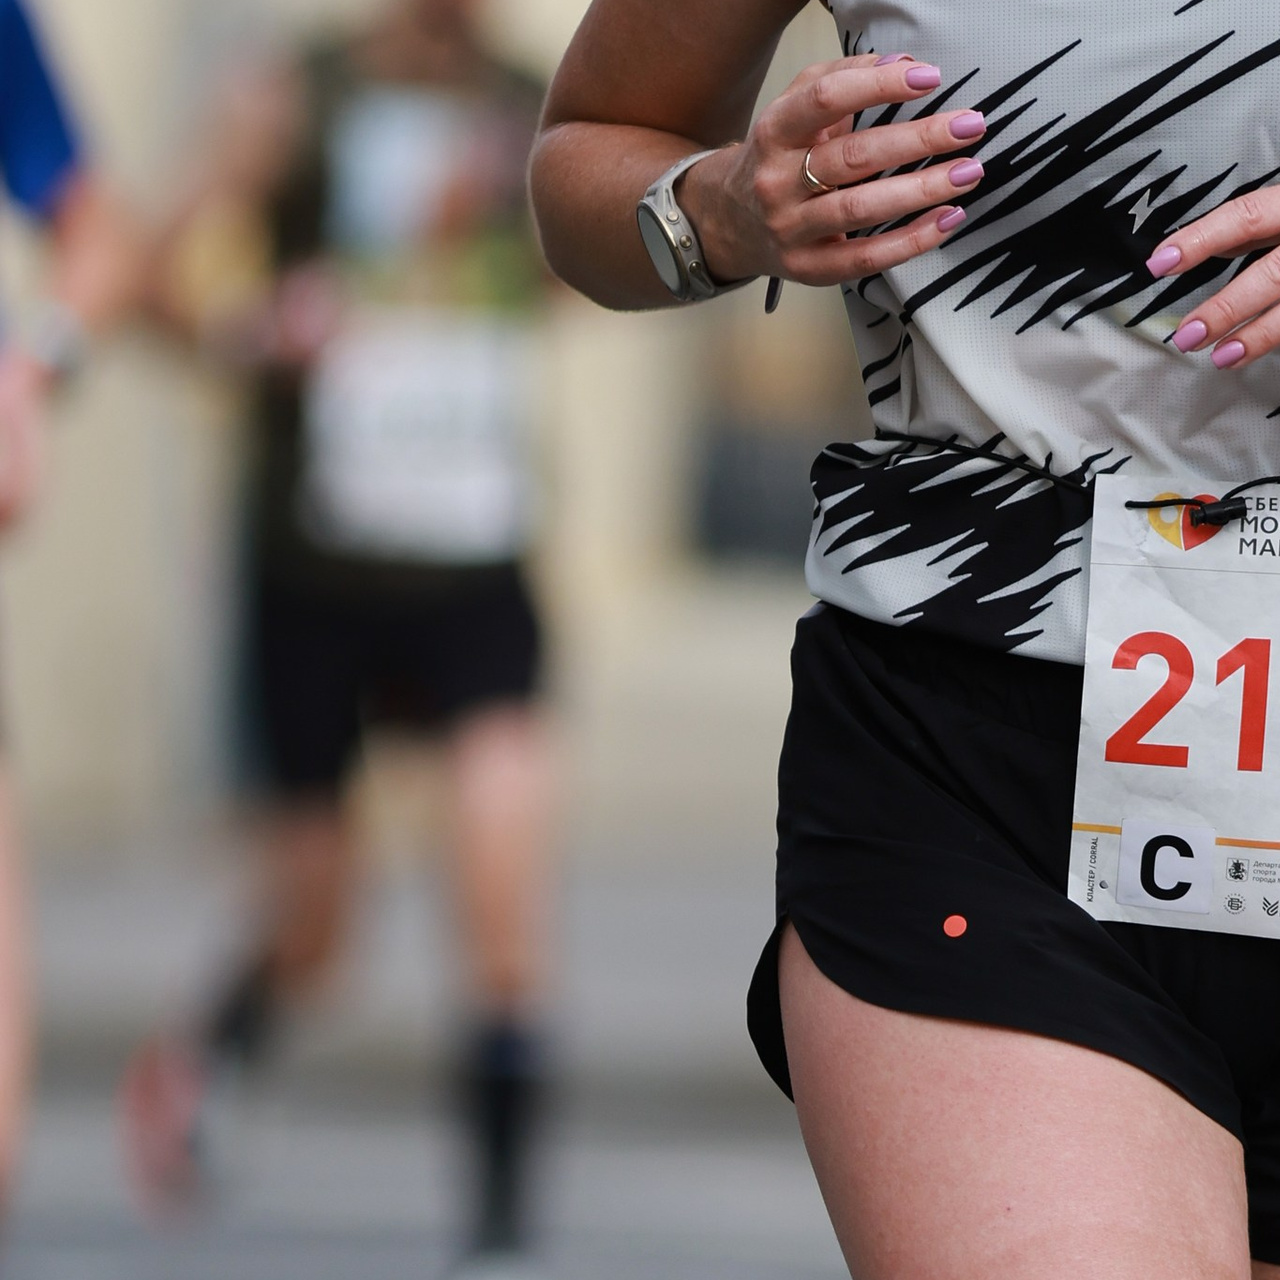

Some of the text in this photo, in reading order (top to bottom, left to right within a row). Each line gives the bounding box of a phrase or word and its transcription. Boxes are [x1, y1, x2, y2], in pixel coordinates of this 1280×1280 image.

[1089, 837, 1099, 864] CORRAL
[1140, 834, 1194, 901] C
[1252, 876, 1276, 884] города
[1253, 868, 1277, 876] спорта
[1087, 868, 1097, 902] КЛАСТЕР
